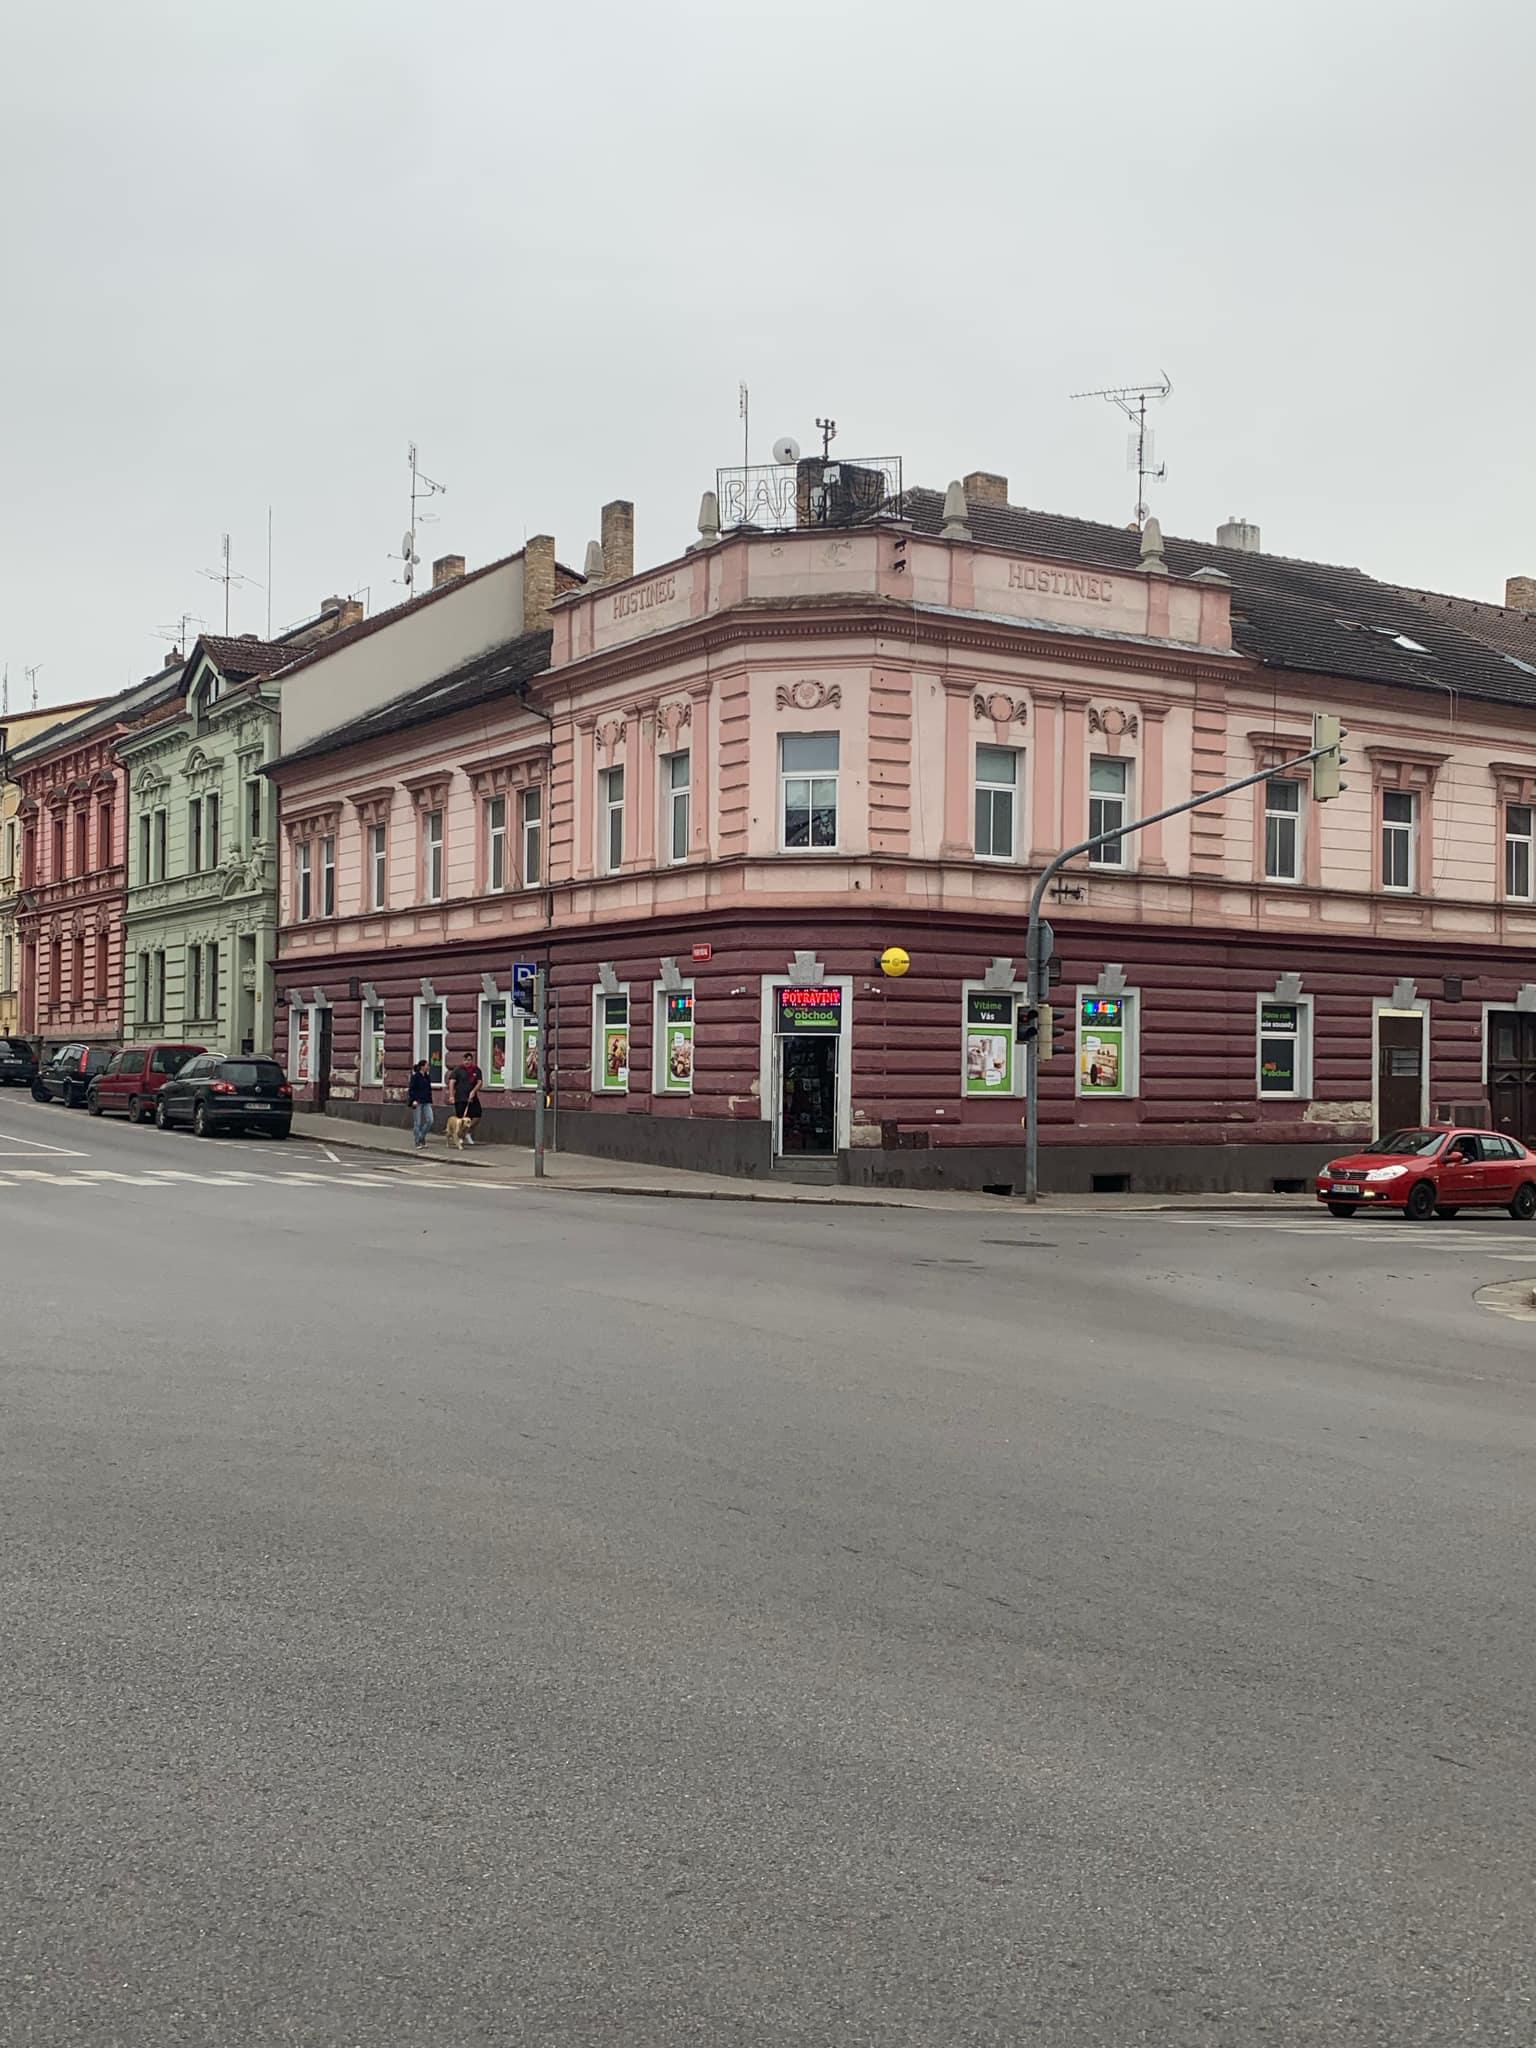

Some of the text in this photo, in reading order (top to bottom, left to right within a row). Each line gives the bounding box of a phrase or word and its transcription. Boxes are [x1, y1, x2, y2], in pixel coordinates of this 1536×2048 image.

[1008, 562, 1113, 602] HOSTINEC
[613, 575, 676, 620] HOSTINEC
[782, 992, 840, 1004] POTRAVINY
[794, 1010, 834, 1020] obchod
[980, 1011, 995, 1021] Vás
